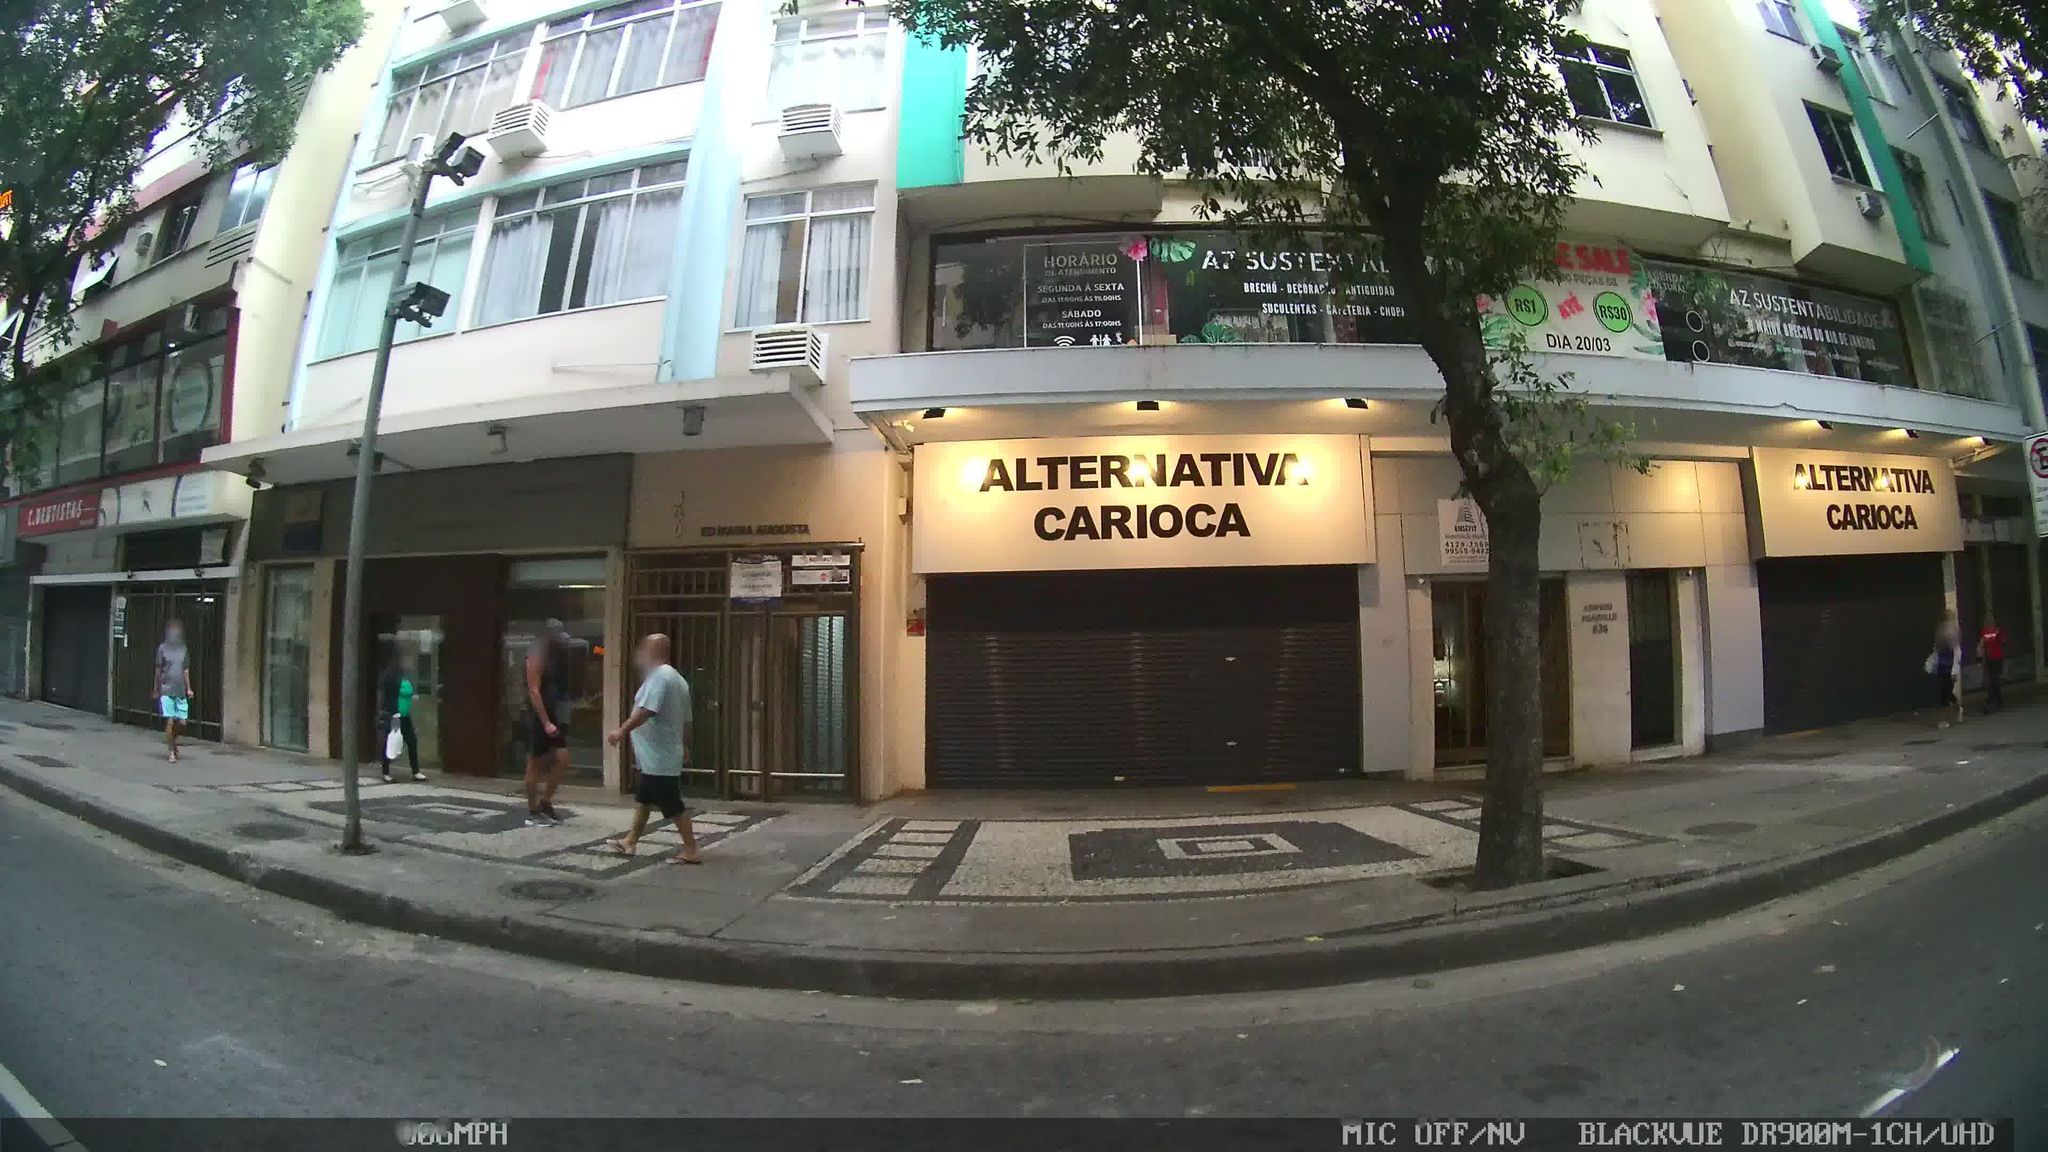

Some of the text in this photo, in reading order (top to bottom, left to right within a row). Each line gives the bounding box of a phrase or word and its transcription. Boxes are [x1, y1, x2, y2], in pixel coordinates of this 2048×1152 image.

[1037, 285, 1082, 293] SEGUNDA
[1094, 283, 1124, 291] SEXTA
[1262, 303, 1317, 315] SUCULENTAS
[1730, 288, 1879, 328] AZ SUSTENTABILIDADE
[1545, 333, 1611, 351] DIA 20/03
[979, 453, 1308, 492] ALTERNATIVA
[1793, 463, 1935, 494] ALTERNATIVA
[756, 524, 810, 535] AUGUSTA
[1034, 503, 1251, 541] CARIOCA
[1826, 504, 1918, 530] CARIOCA
